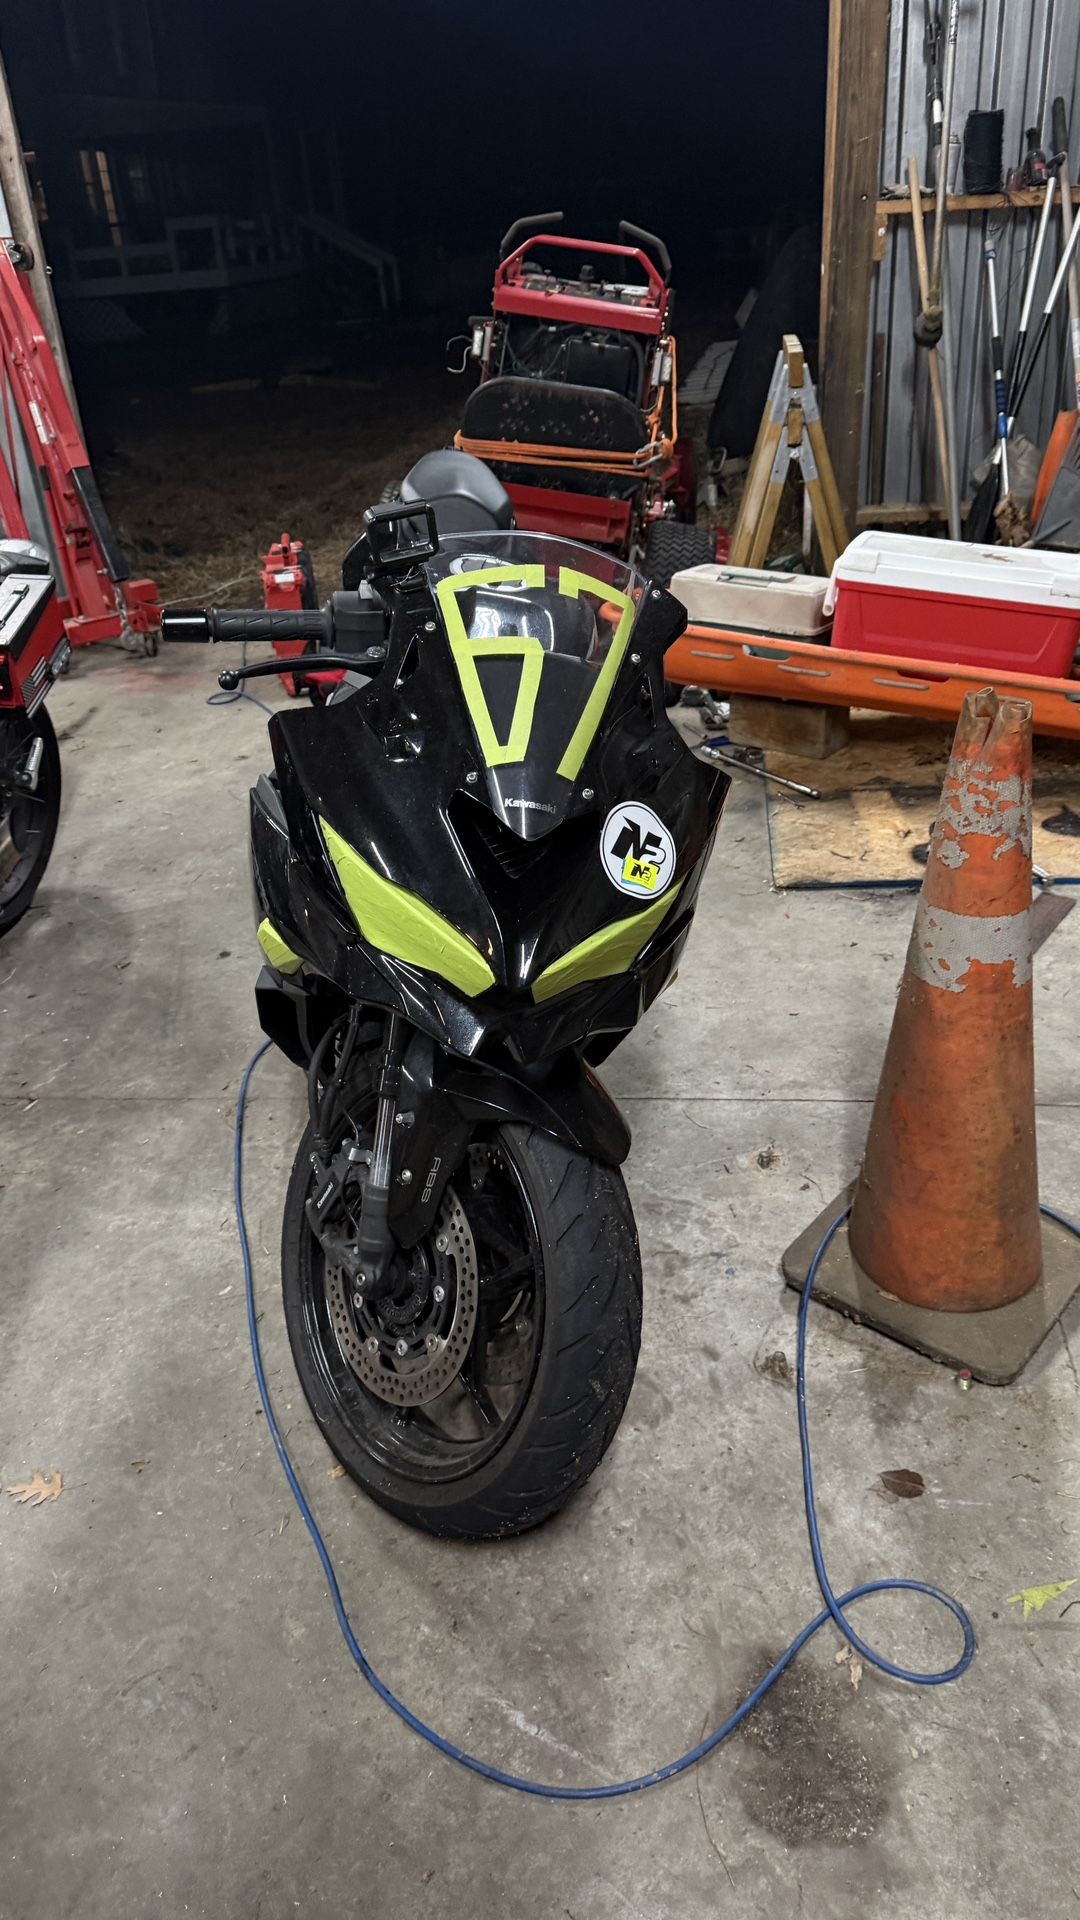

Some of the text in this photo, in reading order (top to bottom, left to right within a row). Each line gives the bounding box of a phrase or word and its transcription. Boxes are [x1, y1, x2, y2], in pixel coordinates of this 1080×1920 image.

[436, 564, 635, 781] 67
[504, 797, 557, 814] Kawasaki
[610, 815, 667, 875] N2
[421, 1157, 442, 1203] ABS
